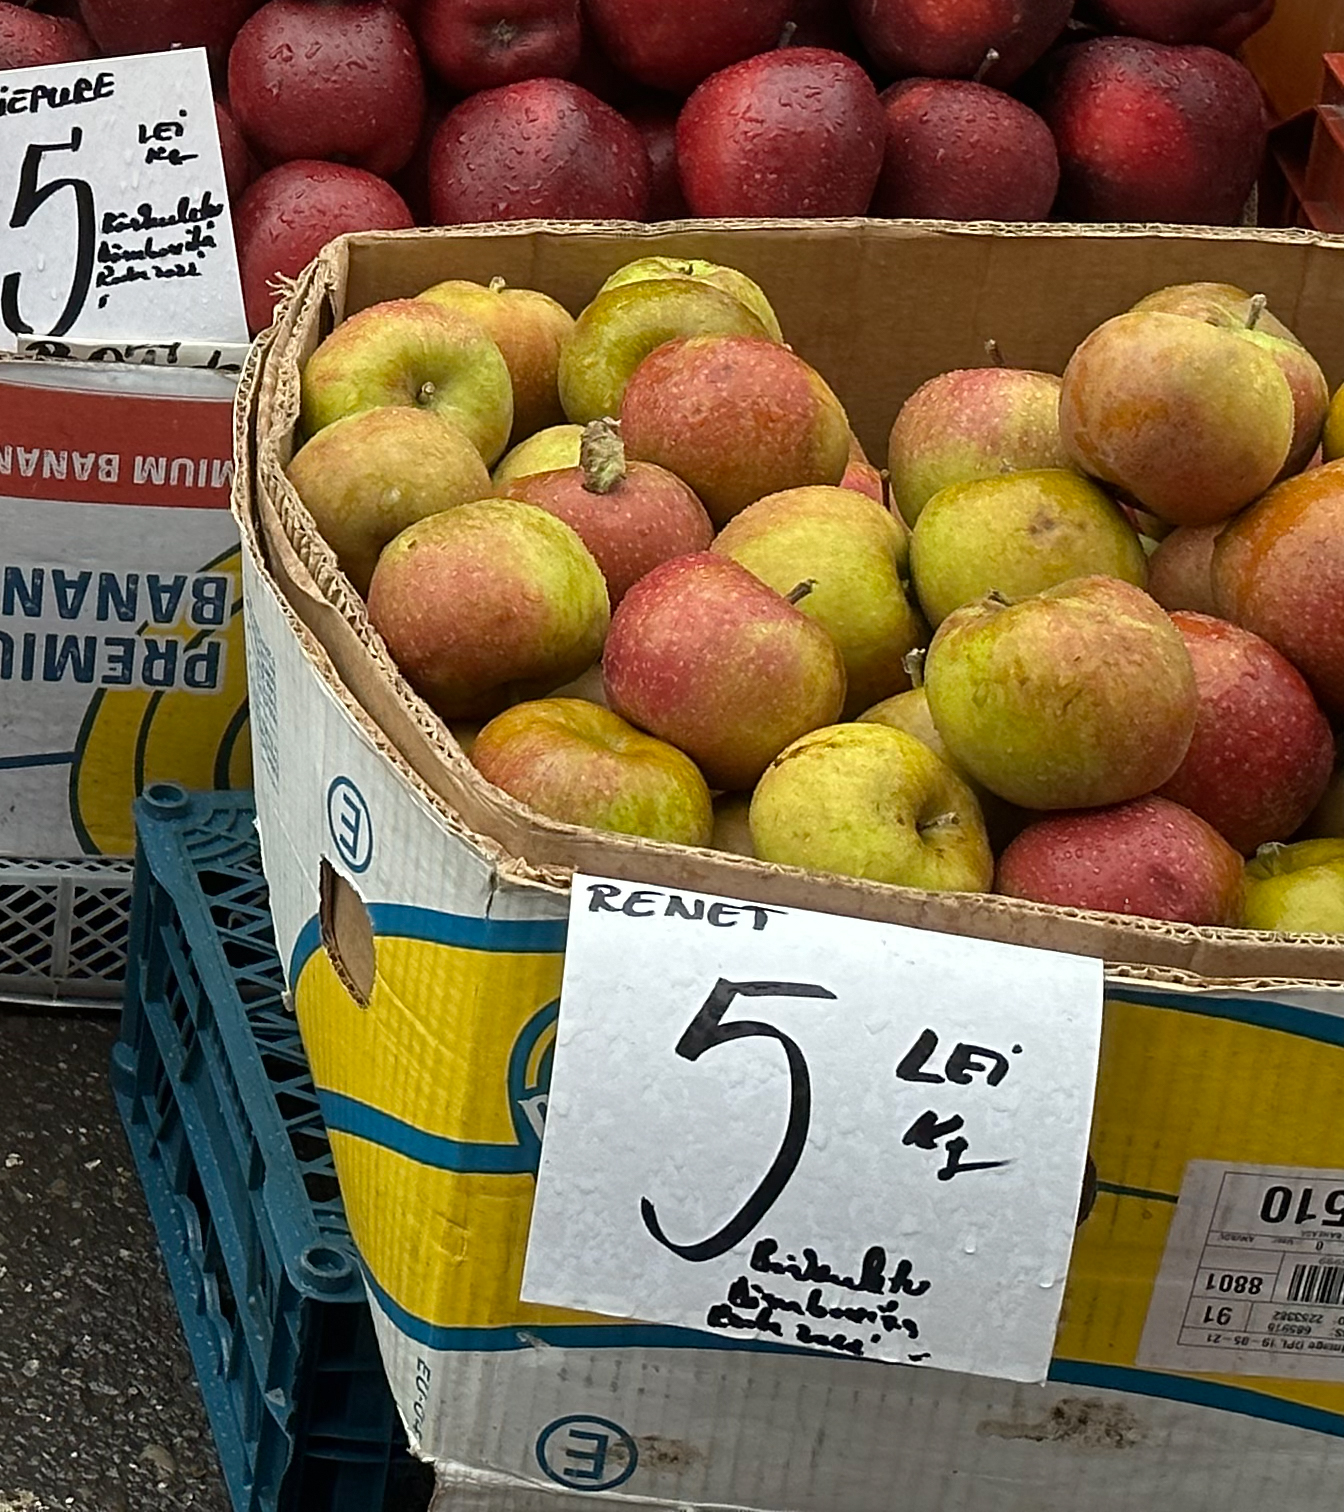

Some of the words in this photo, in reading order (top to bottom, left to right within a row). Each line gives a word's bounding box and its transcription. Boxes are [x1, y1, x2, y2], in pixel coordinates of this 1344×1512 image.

[0, 126, 96, 337] 5
[586, 884, 789, 932] RENET
[639, 976, 838, 1263] 5
[1206, 1273, 1263, 1295] 8801
[1203, 1305, 1233, 1325] 91
